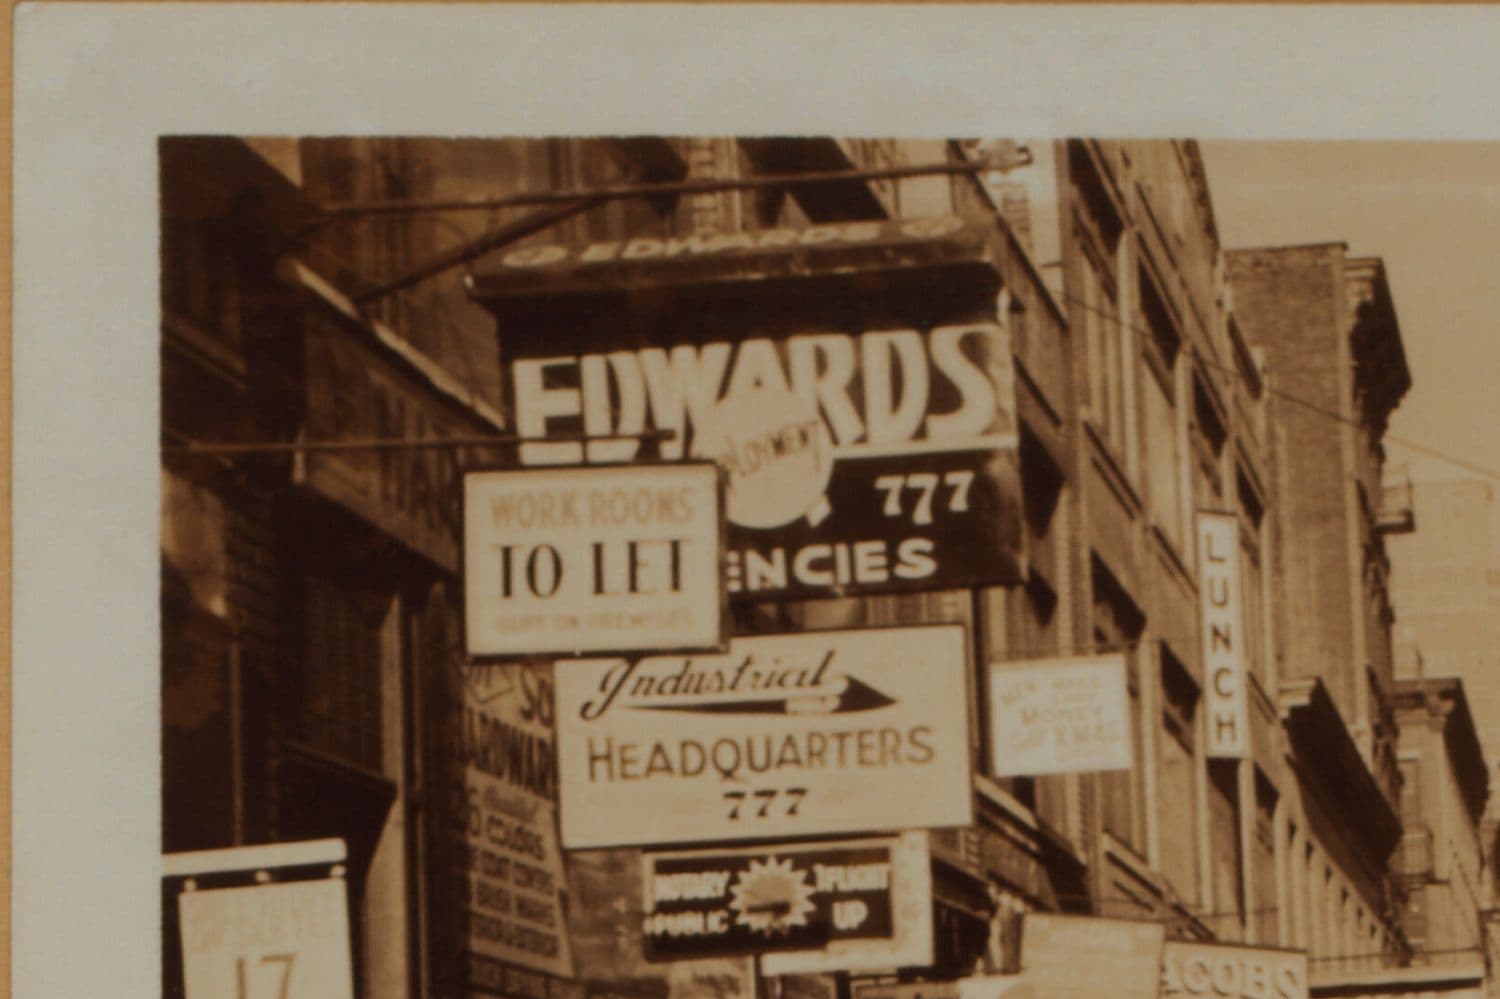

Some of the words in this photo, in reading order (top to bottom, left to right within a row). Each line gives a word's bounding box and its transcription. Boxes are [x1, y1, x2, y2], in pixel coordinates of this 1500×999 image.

[579, 222, 882, 262] EDWARDS
[513, 323, 1007, 467] EDWARDS
[488, 493, 578, 528] WORK
[589, 487, 696, 525] ROOMS
[875, 471, 974, 526] 777
[489, 541, 564, 601] TO
[590, 537, 694, 597] LET
[1206, 531, 1238, 744] LUNCH
[580, 649, 835, 720] Industrial
[587, 727, 935, 783] HEADQUARTERS
[723, 788, 809, 821] 777
[831, 900, 869, 931] UP
